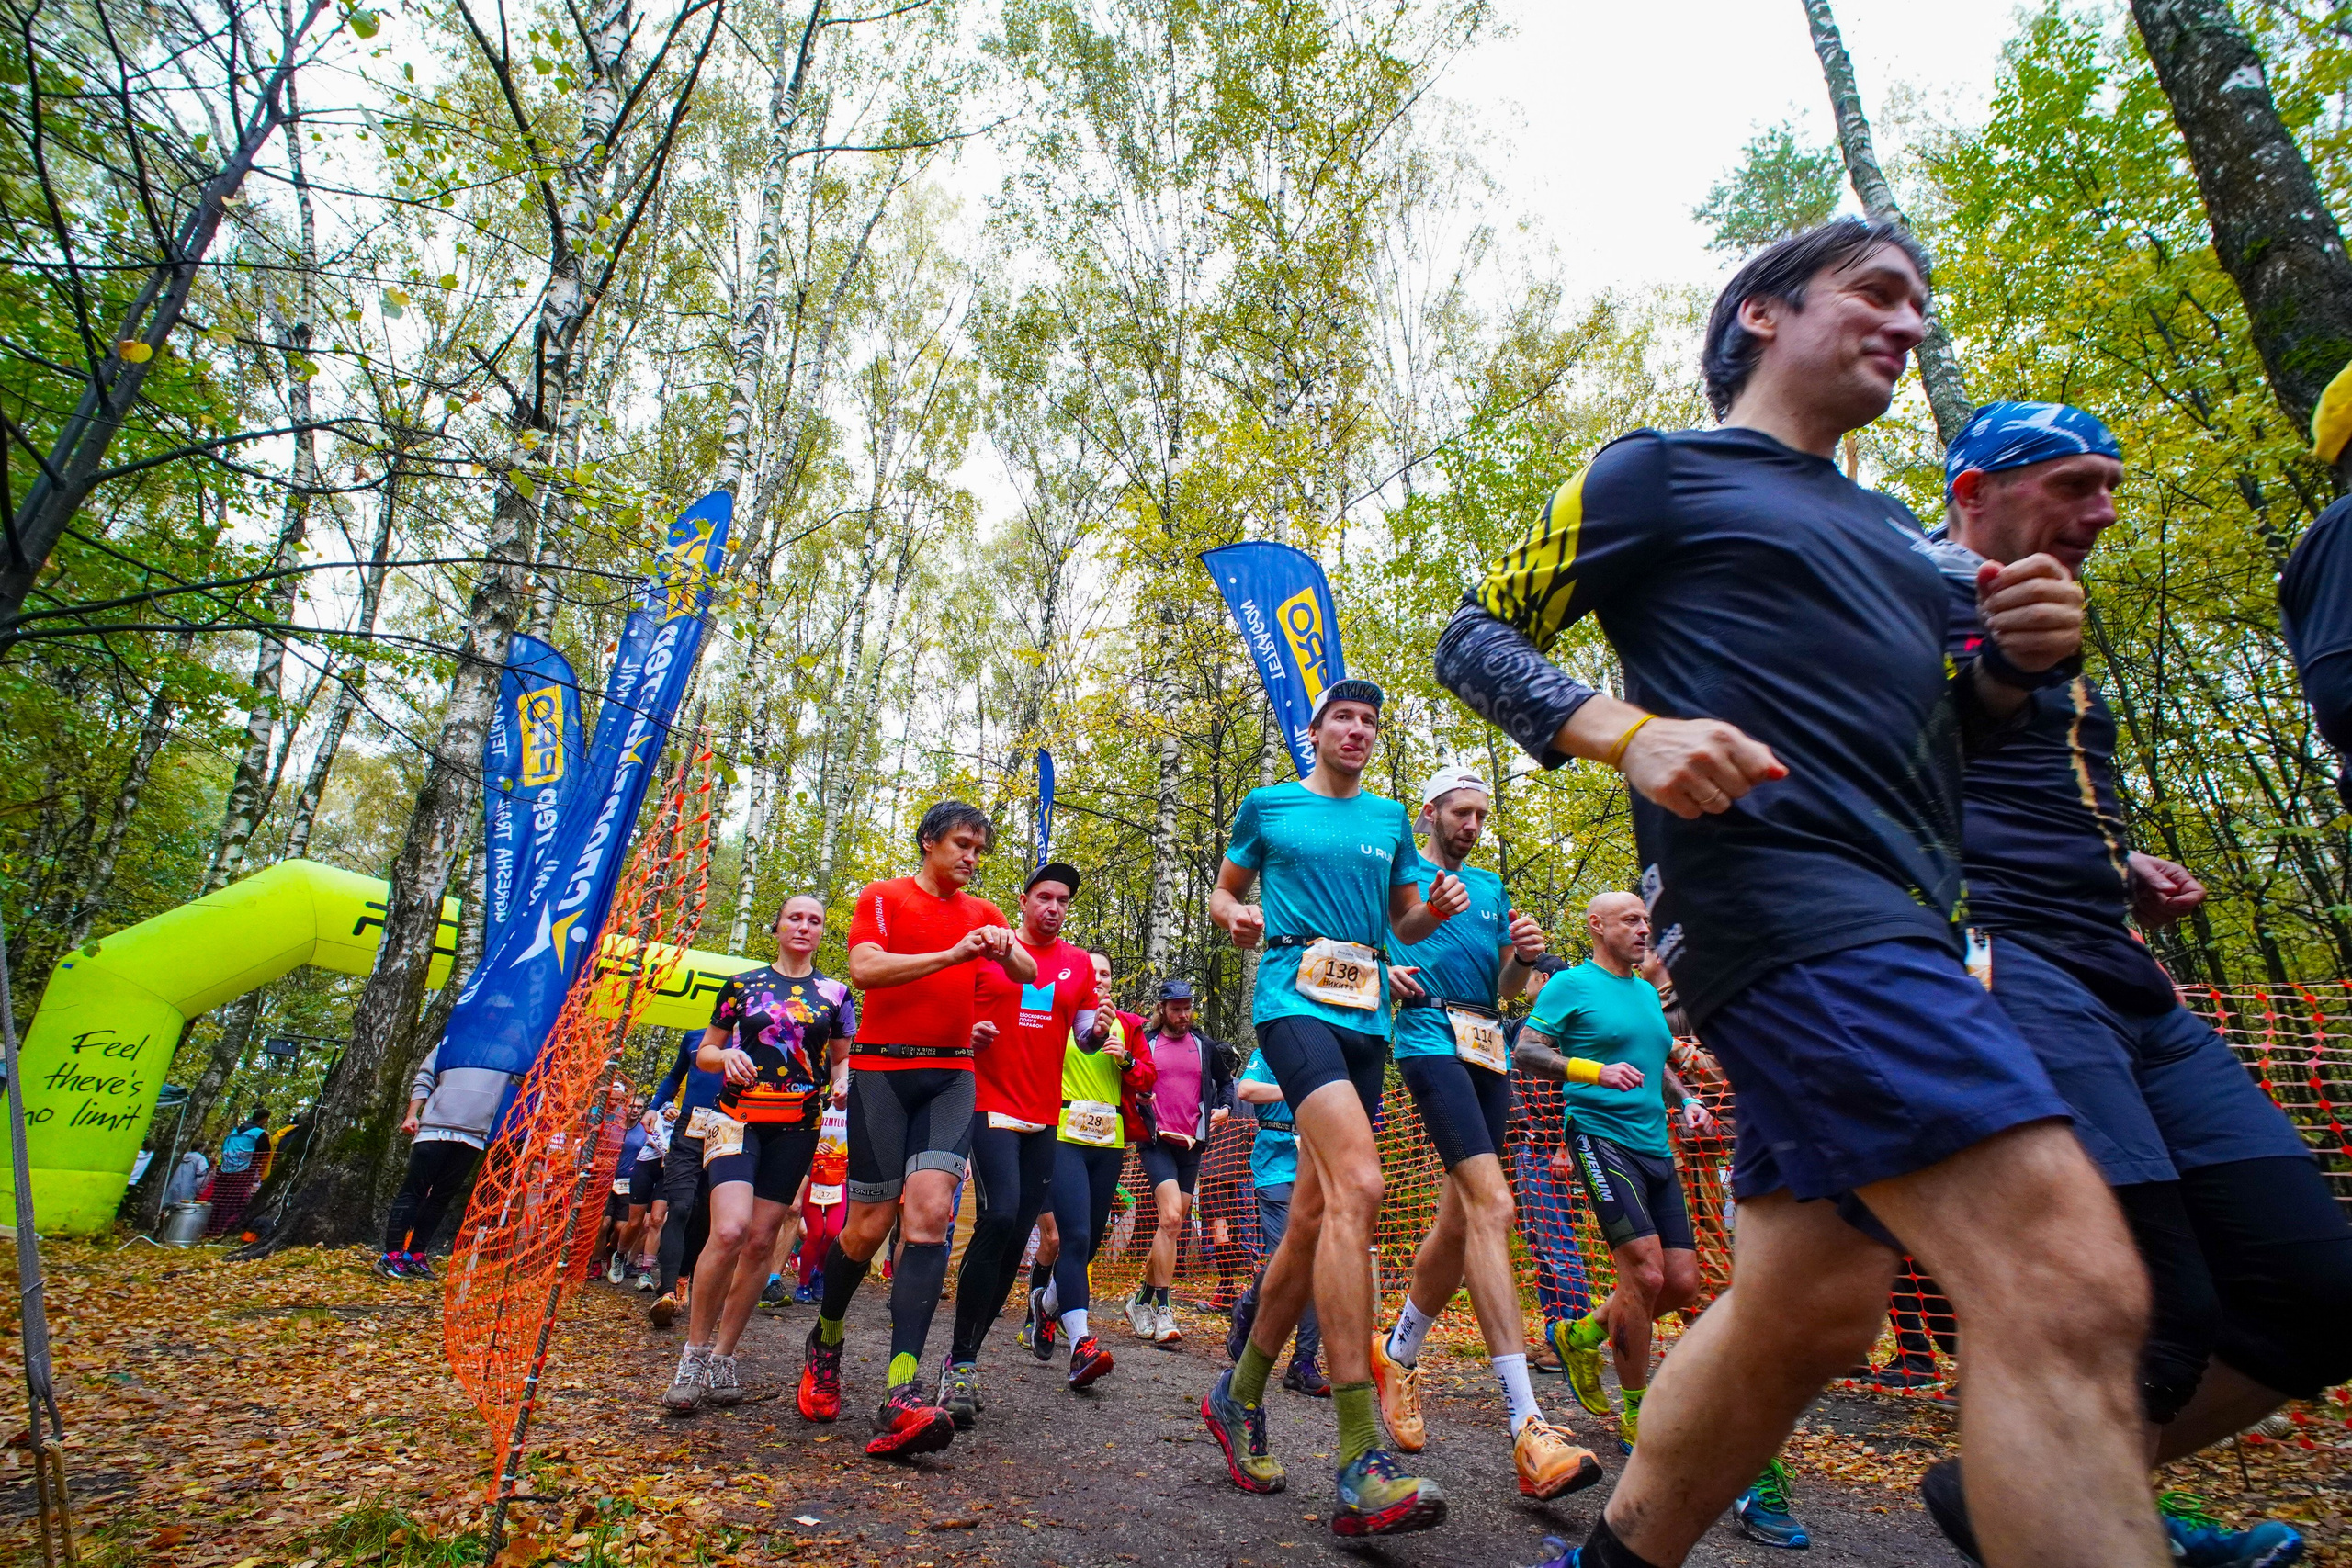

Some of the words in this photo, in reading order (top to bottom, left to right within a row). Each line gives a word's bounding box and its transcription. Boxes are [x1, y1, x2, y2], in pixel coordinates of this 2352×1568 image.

[1325, 961, 1359, 982] 130
[1323, 978, 1354, 992] Никита
[71, 1030, 150, 1061] Feel
[1473, 1026, 1493, 1045] 114
[44, 1062, 144, 1098] there's
[69, 1098, 142, 1132] limit
[1087, 1114, 1102, 1127] 28
[1584, 1151, 1615, 1201] VENUM
